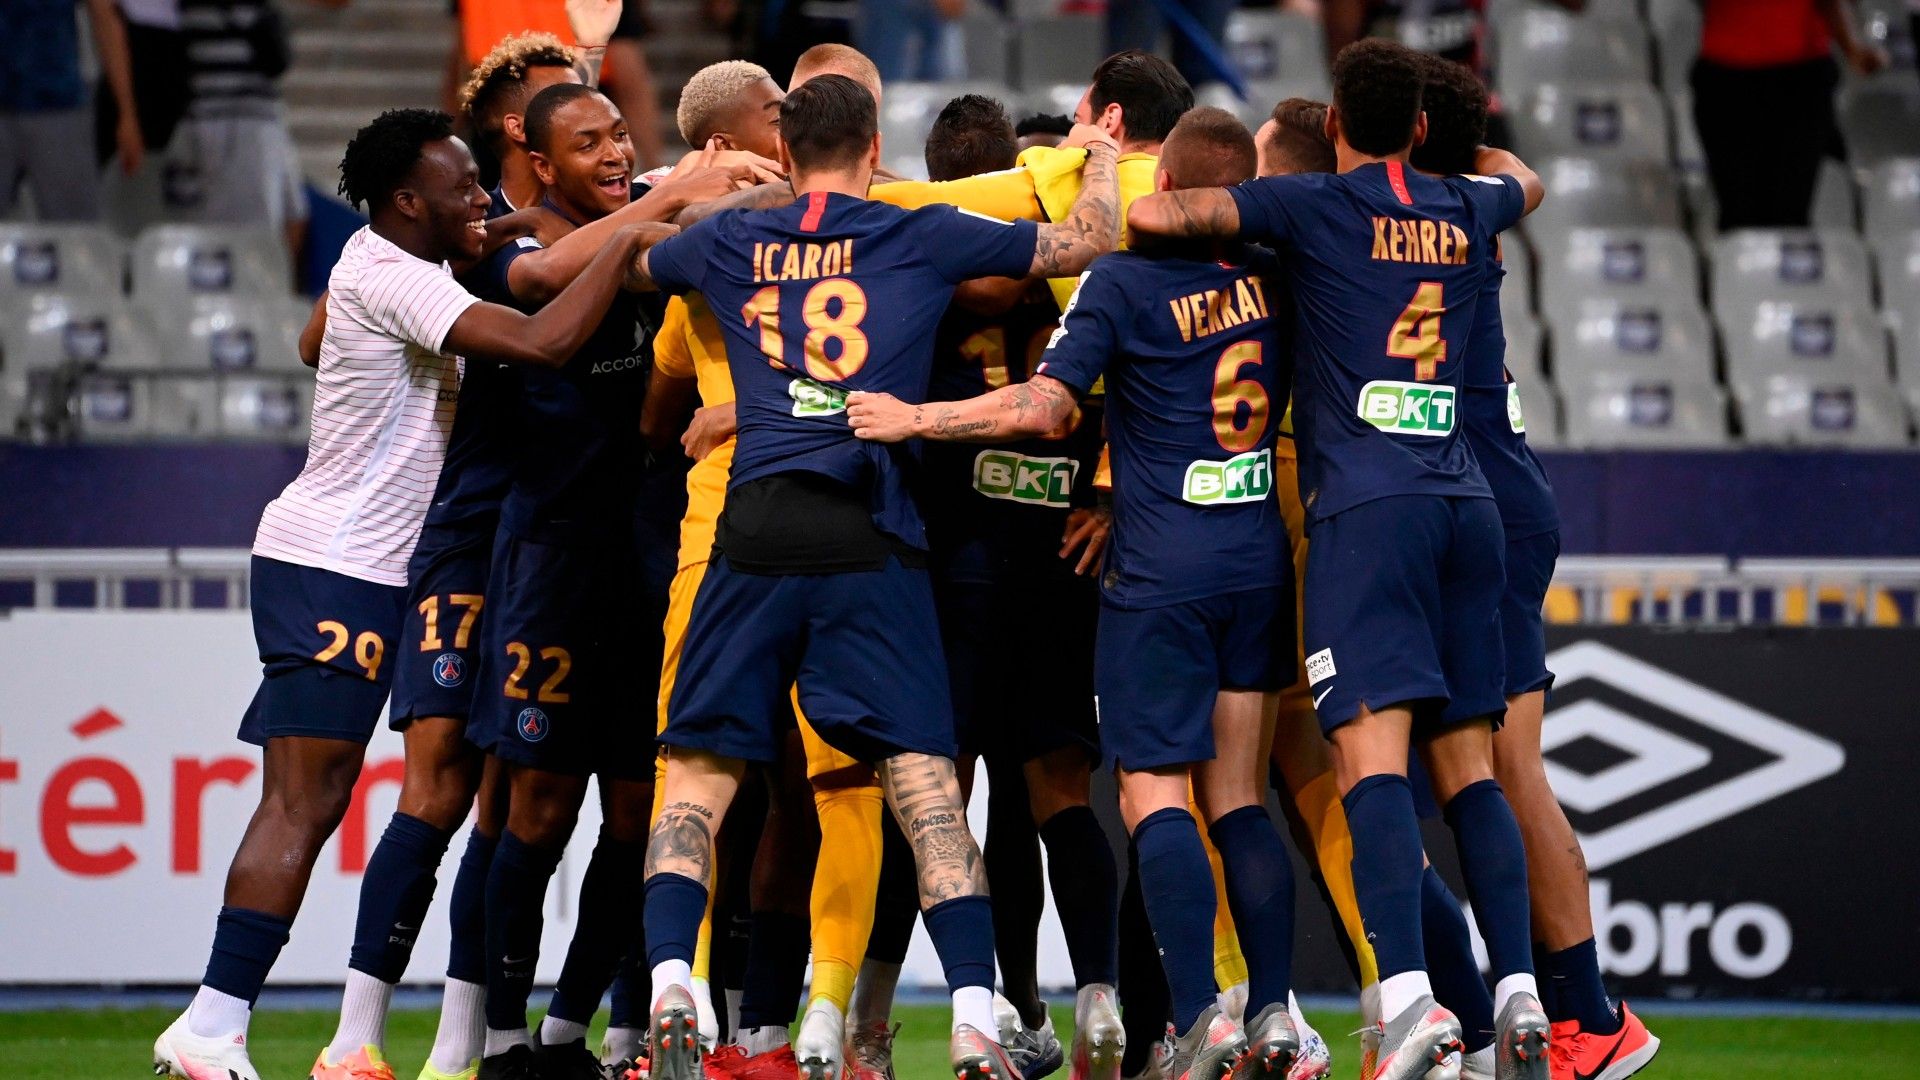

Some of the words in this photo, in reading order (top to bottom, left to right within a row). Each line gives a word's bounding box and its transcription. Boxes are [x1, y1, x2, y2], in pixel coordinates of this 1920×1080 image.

[1371, 216, 1469, 265] KEHRER
[740, 277, 869, 382] 18
[1169, 275, 1279, 342] VERRAT
[1386, 281, 1447, 382] 4
[1211, 340, 1270, 453] 6
[1365, 393, 1453, 424] BKT
[982, 461, 1070, 495] BKT
[1191, 462, 1267, 496] BKT
[313, 620, 385, 681] 29
[418, 594, 485, 652] 17
[503, 641, 573, 703] 22
[1311, 663, 1332, 680] sport
